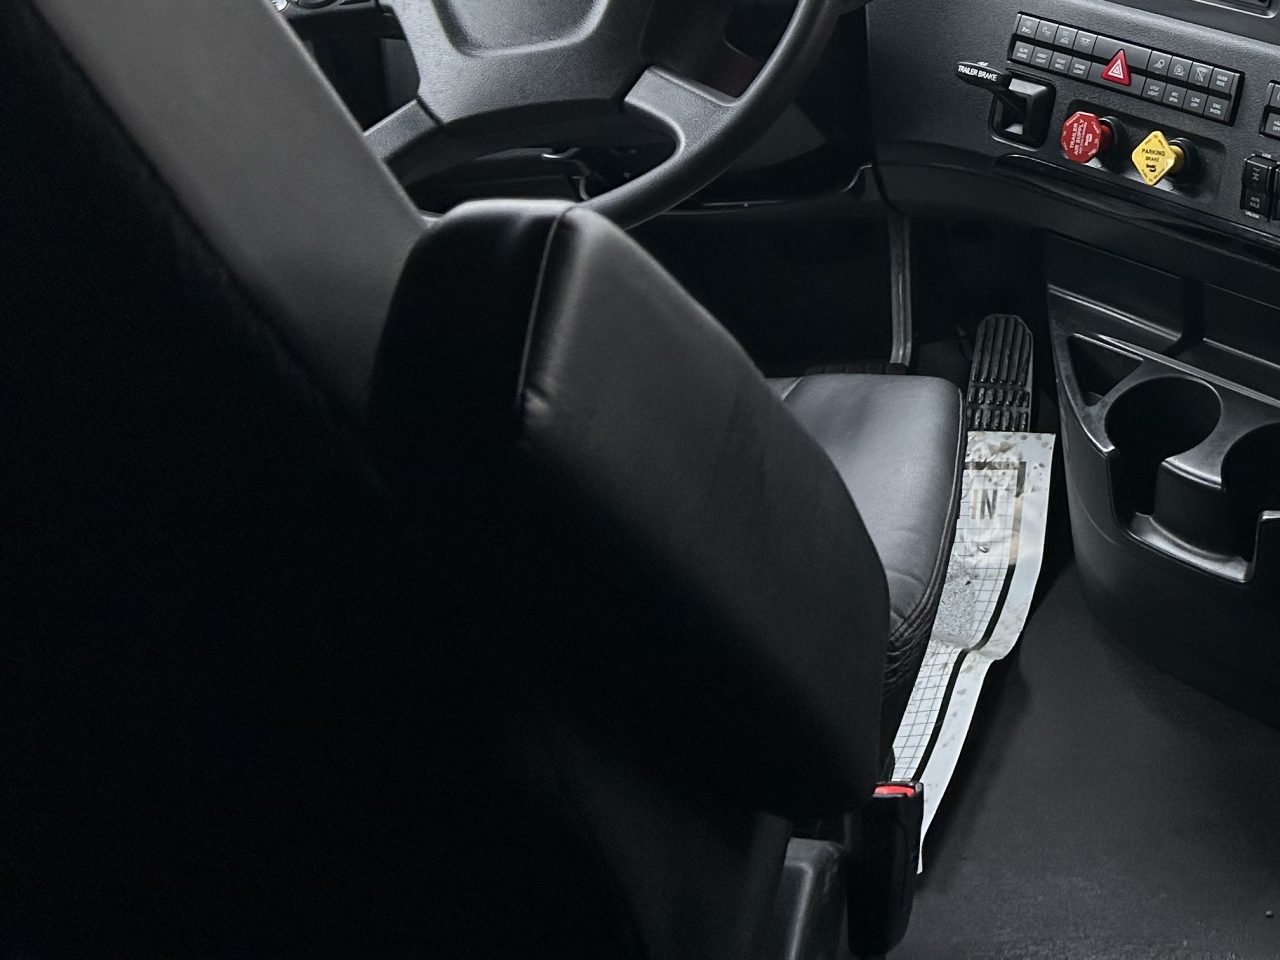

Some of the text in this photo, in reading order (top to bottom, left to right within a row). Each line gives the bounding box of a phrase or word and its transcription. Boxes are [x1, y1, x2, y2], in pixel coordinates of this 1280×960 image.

[958, 64, 978, 76] TRAILER
[978, 70, 998, 81] BRAKE
[1141, 148, 1165, 157] PARKING
